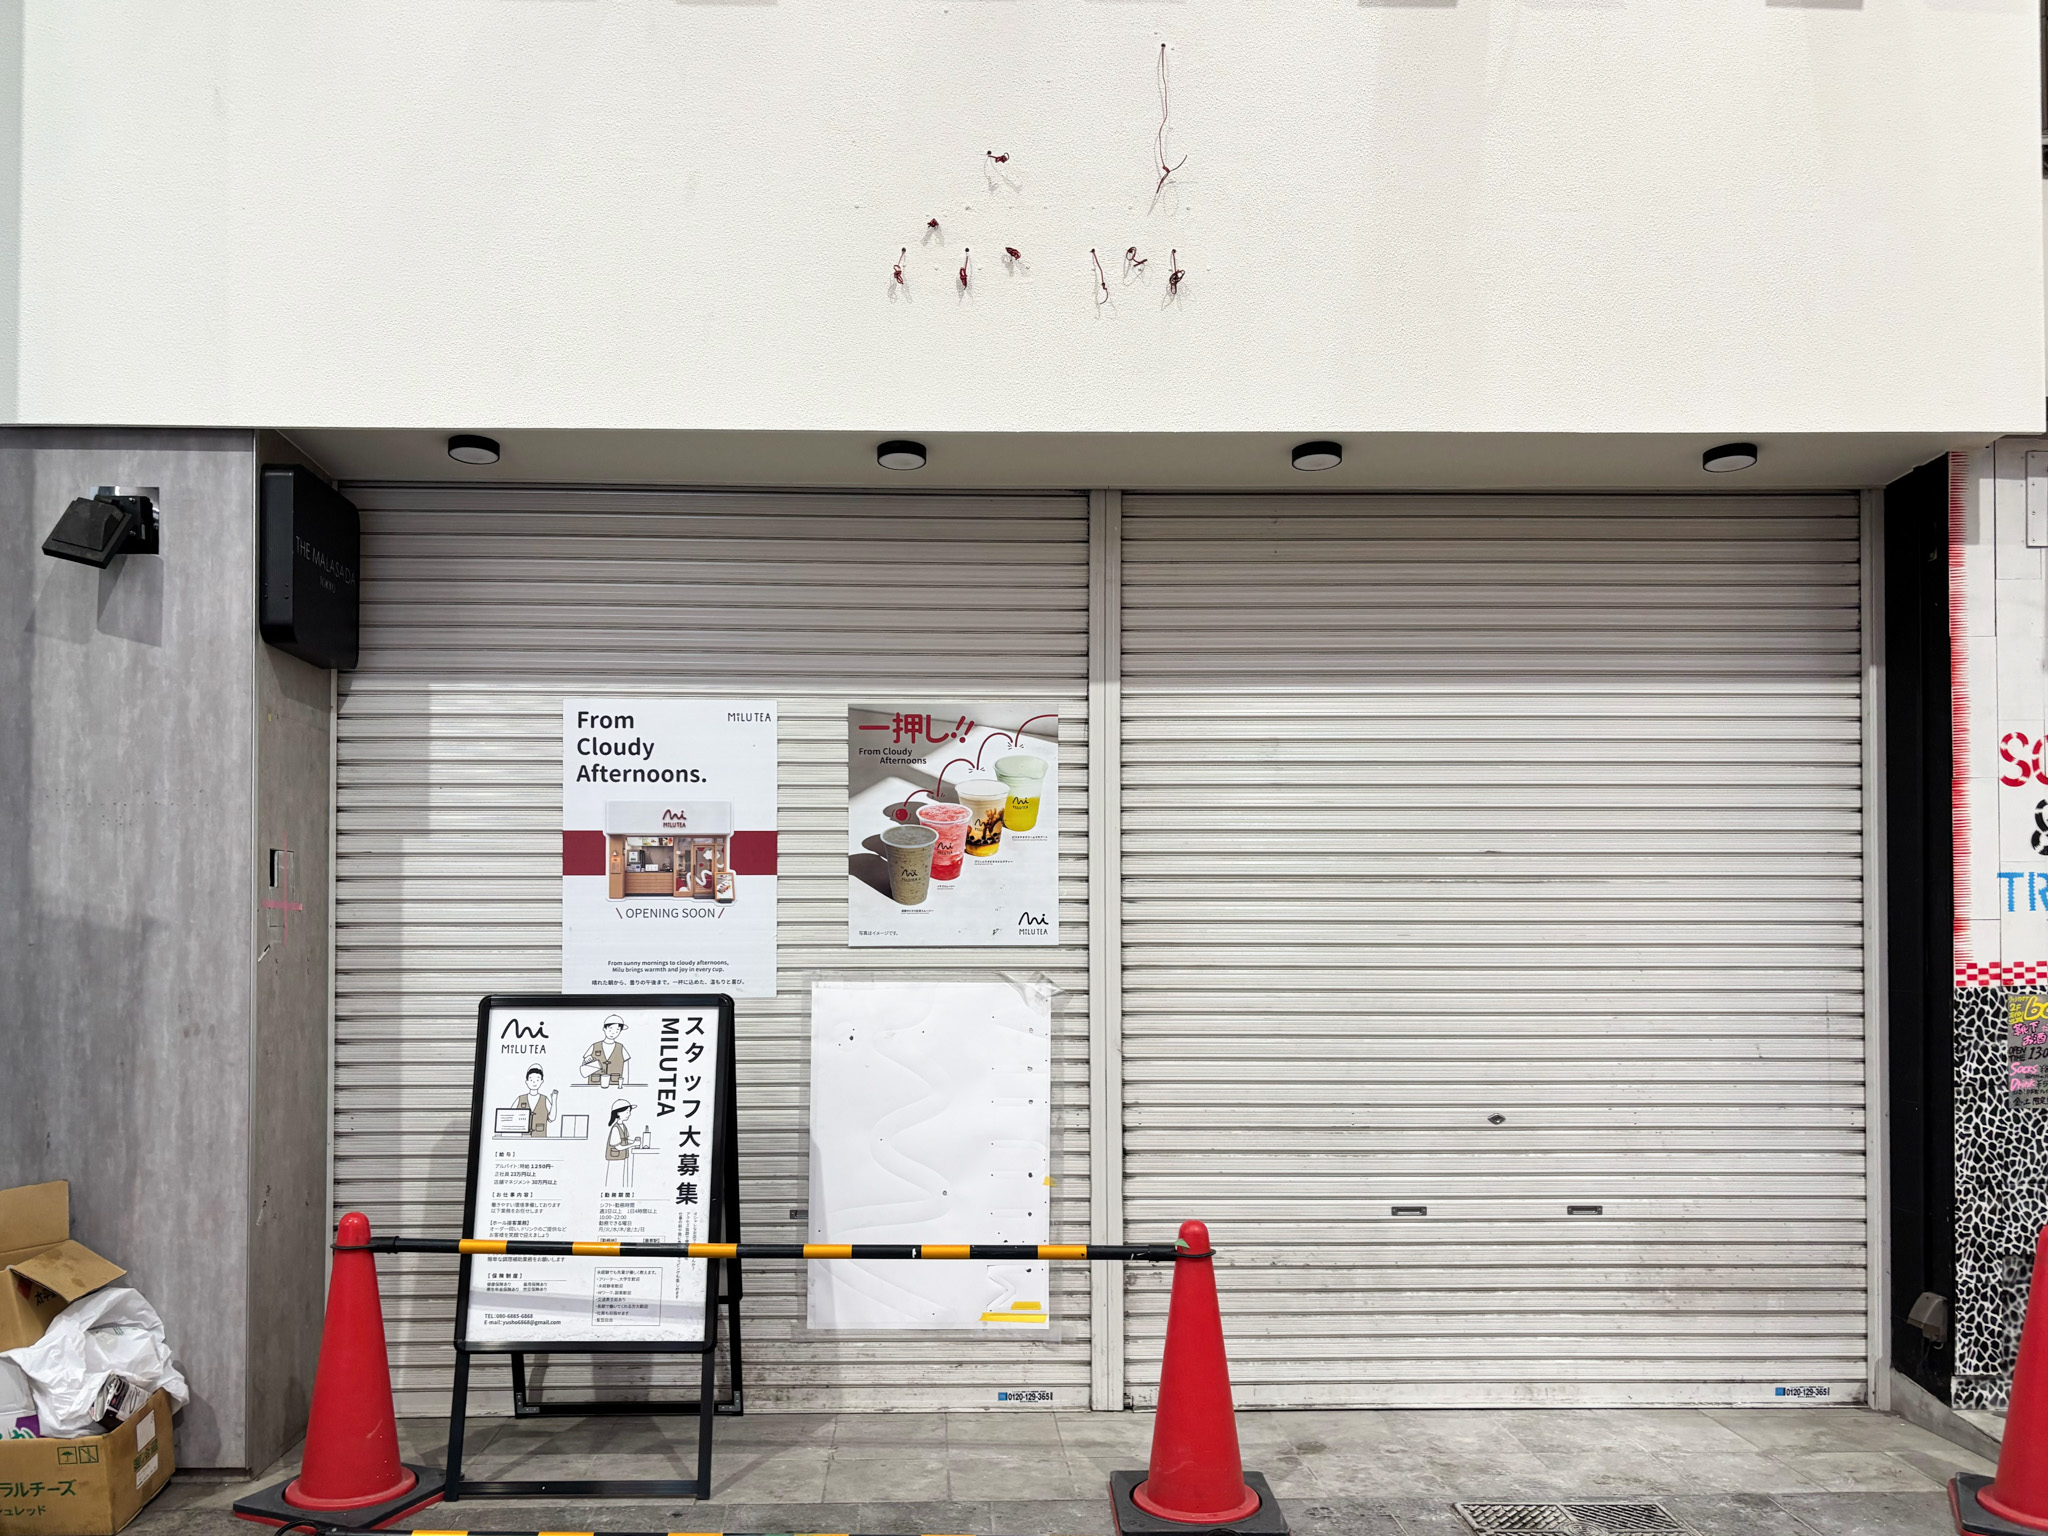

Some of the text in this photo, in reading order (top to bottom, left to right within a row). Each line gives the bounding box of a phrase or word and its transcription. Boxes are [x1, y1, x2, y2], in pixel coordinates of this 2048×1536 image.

[296, 536, 356, 588] THE MALASADA
[577, 711, 634, 729] From
[576, 737, 654, 760] Cloudy
[858, 748, 912, 757] From Cloudy
[880, 757, 926, 765] Afternoons
[576, 764, 708, 783] Afternoons.
[625, 908, 716, 919] OPENING SOON
[676, 1016, 705, 1205] スタッフ大募集
[1008, 1392, 1050, 1401] 0120-129-365
[1786, 1388, 1827, 1396] 0120-129-365
